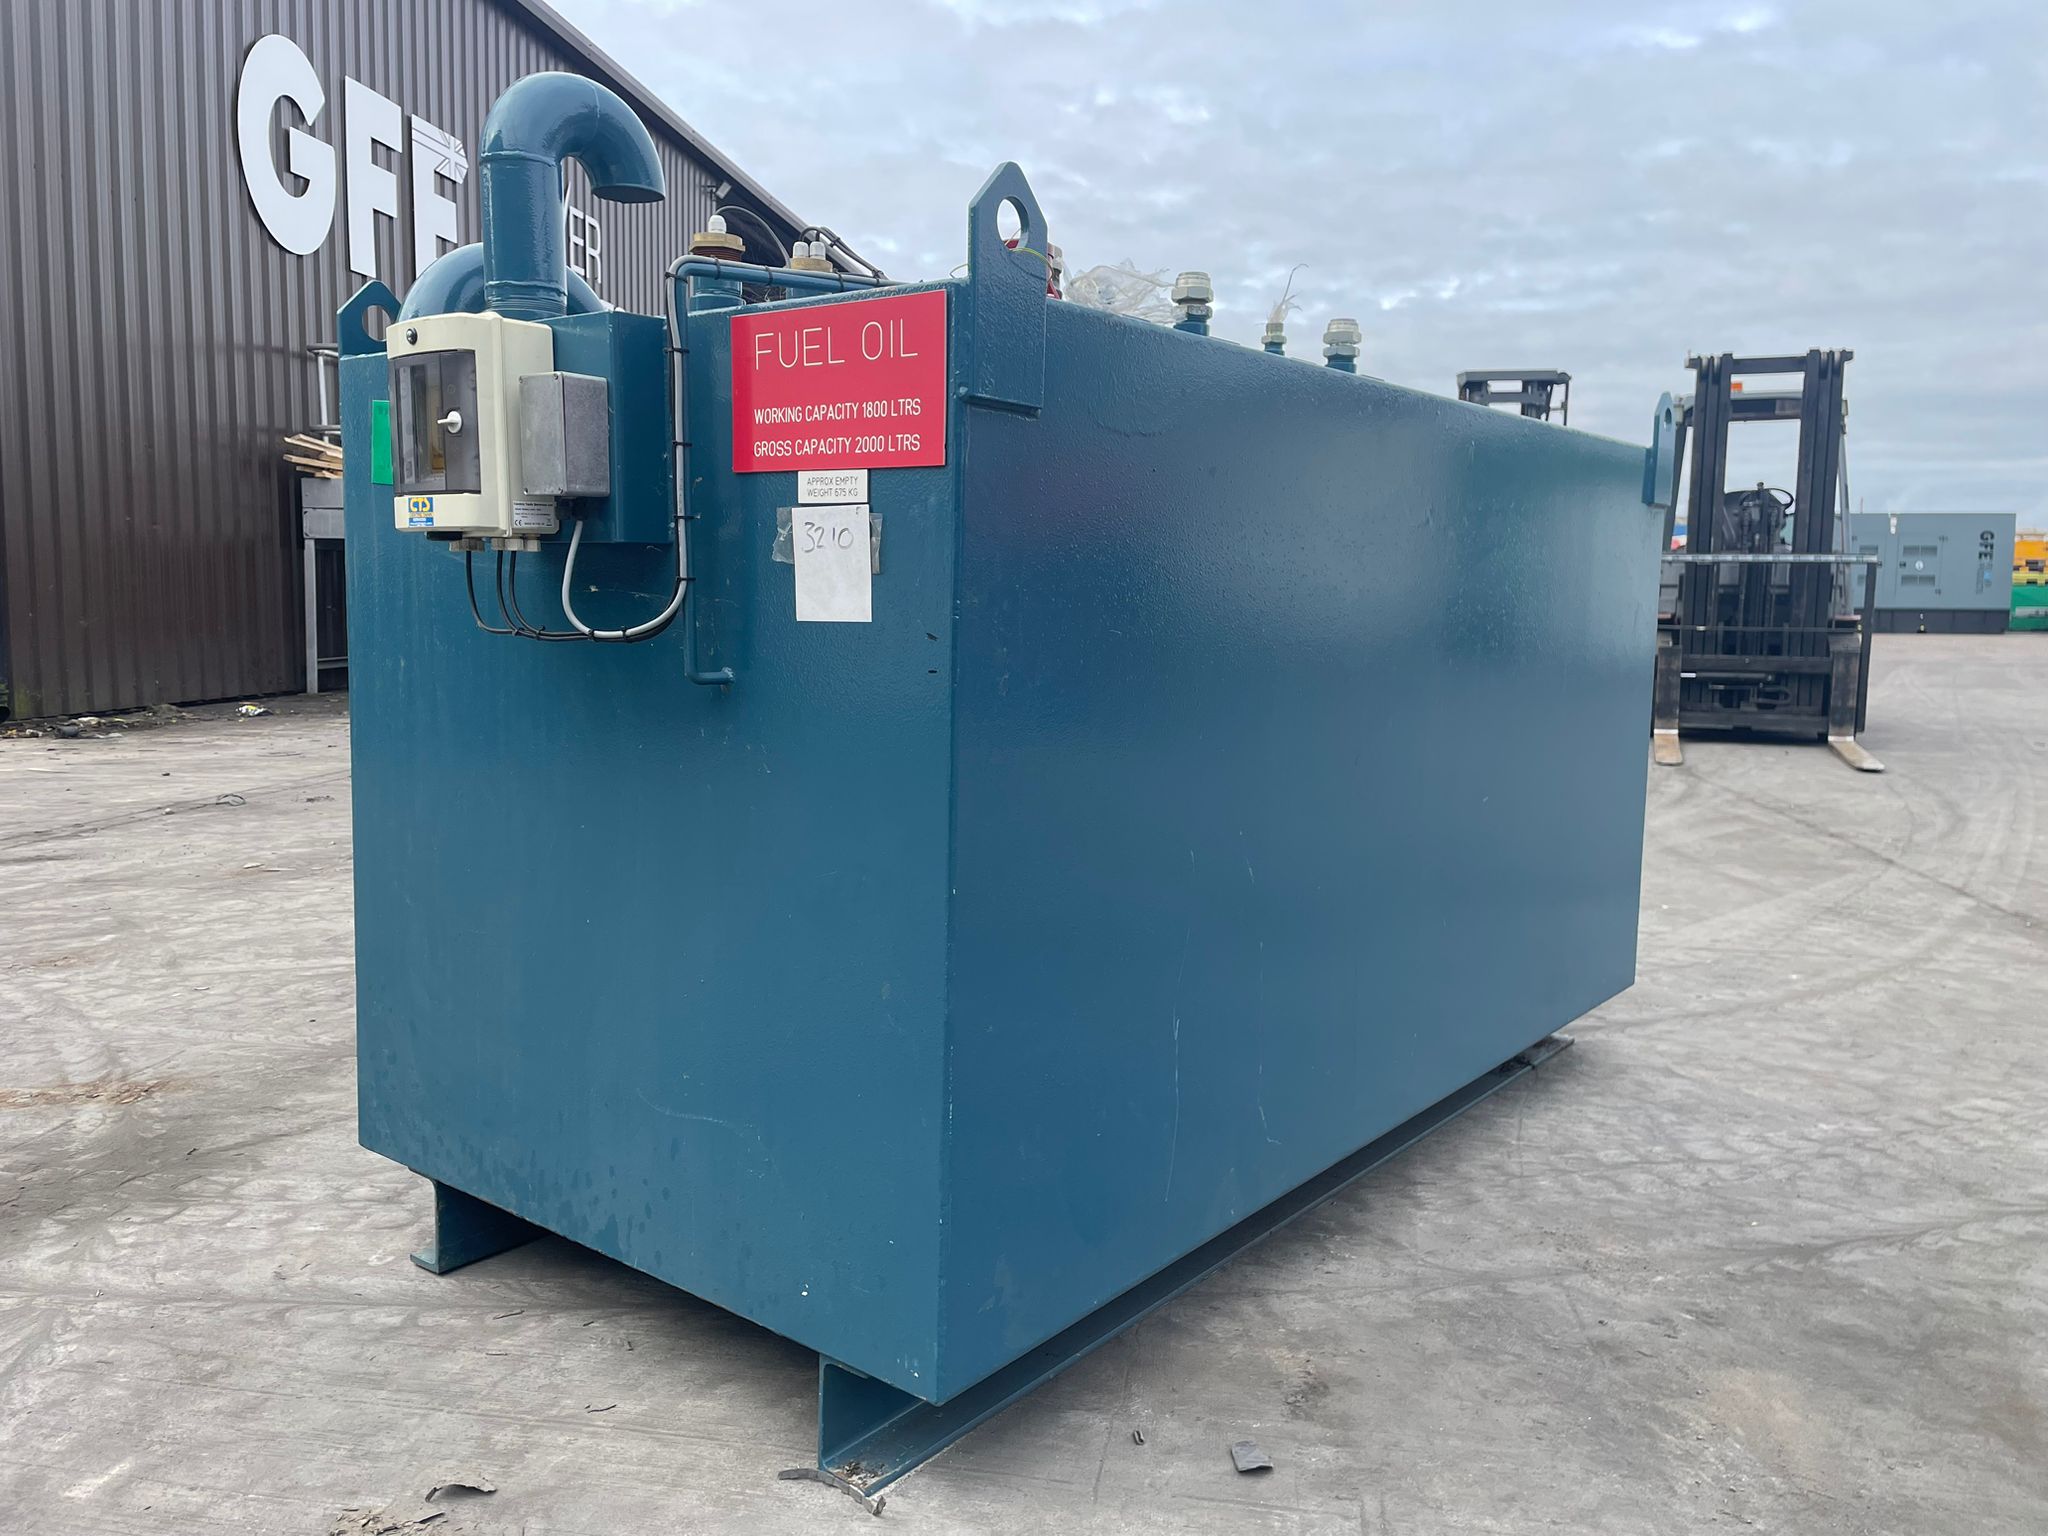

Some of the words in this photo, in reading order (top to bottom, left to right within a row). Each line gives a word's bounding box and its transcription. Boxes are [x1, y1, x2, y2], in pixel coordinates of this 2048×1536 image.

[565, 184, 601, 284] ER
[755, 326, 845, 370] FUEL
[862, 318, 918, 361] OIL
[754, 406, 802, 424] WORKING
[805, 402, 859, 422] CAPACITY
[862, 400, 887, 418] 1800
[891, 398, 921, 416] LTRS
[754, 440, 792, 457] GROSS
[795, 437, 851, 455] CAPACITY
[855, 435, 885, 453] 2000
[888, 434, 921, 452] LTRS
[807, 477, 833, 486] APPROX
[835, 476, 858, 486] EMPTY
[807, 488, 832, 497] WEIGHT
[849, 487, 858, 497] KG
[802, 521, 854, 553] 3210
